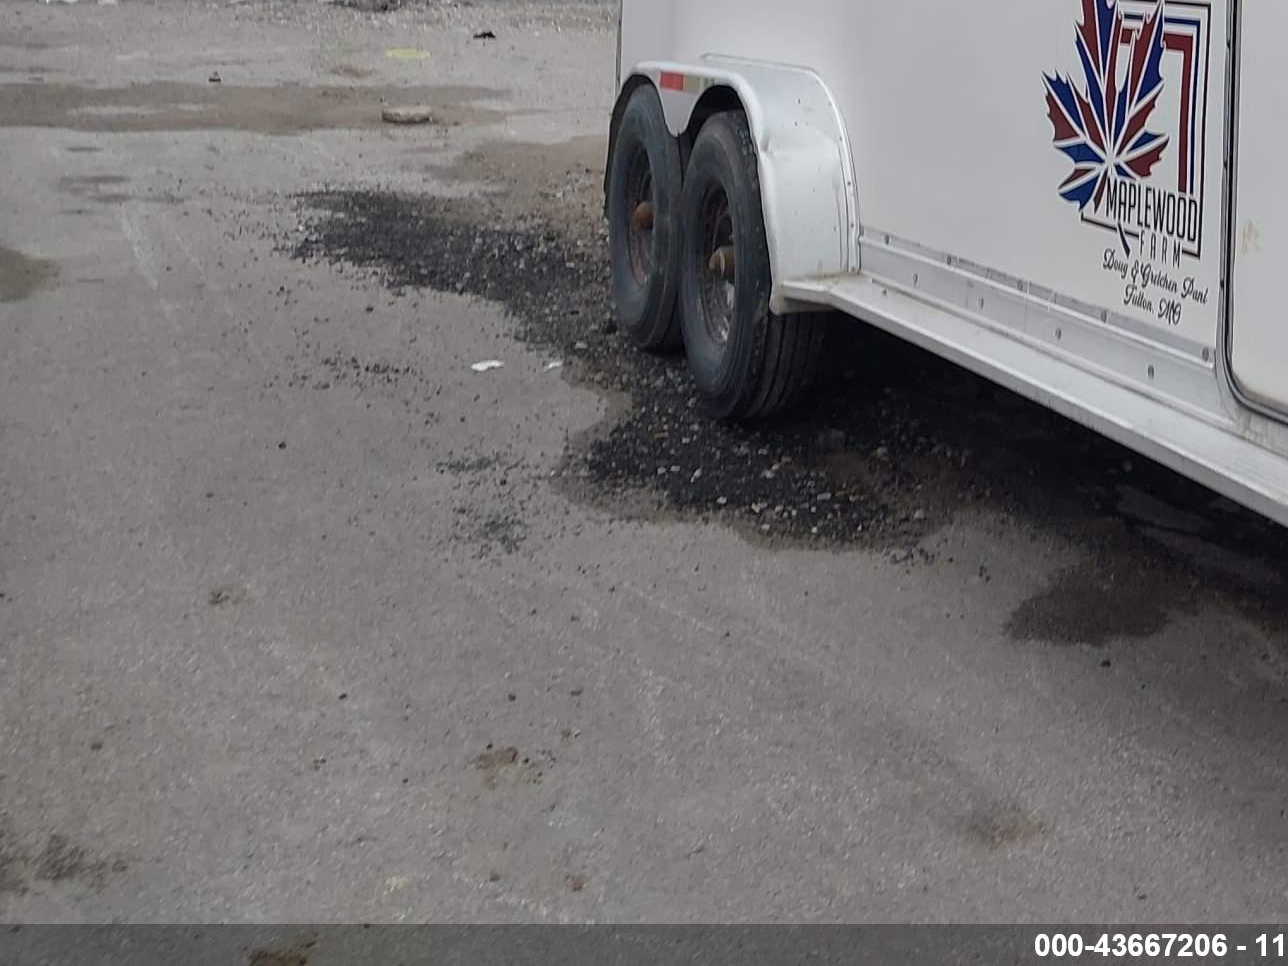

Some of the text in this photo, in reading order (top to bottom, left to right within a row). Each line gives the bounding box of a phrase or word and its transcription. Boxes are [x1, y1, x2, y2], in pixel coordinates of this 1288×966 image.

[1106, 177, 1198, 242] MAPLEWOOD
[1103, 248, 1129, 279] Doug
[1131, 259, 1140, 284] &
[1140, 230, 1181, 270] FARM
[1158, 297, 1182, 326] MO
